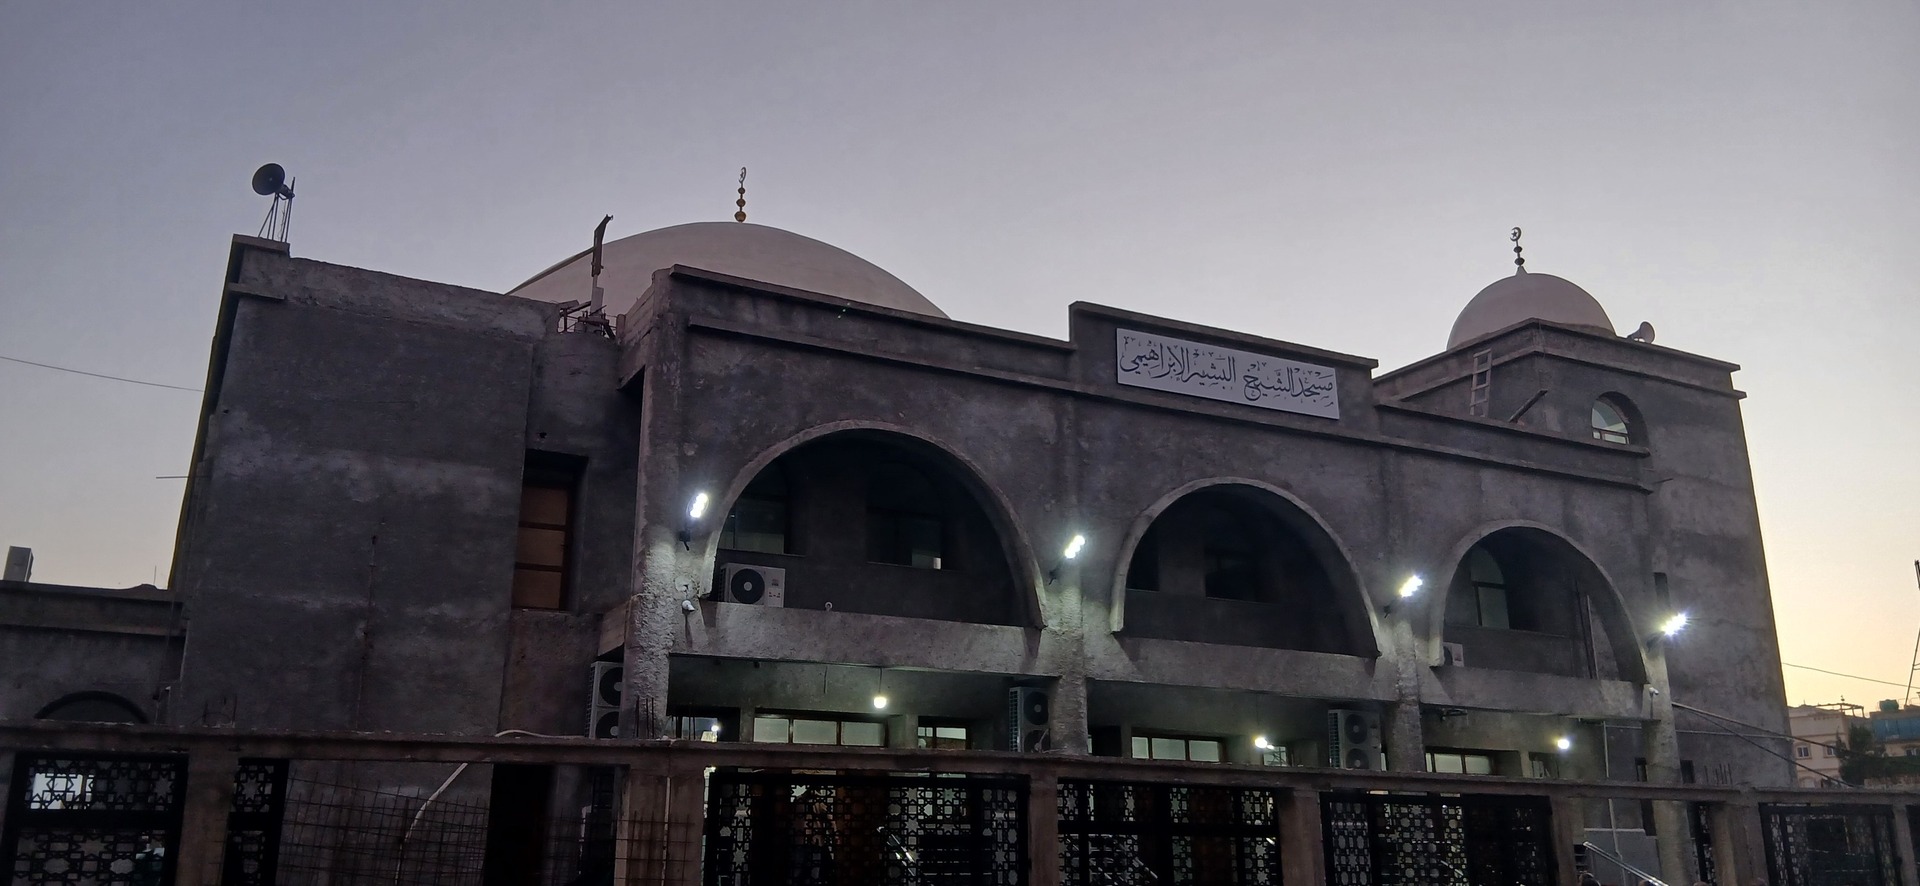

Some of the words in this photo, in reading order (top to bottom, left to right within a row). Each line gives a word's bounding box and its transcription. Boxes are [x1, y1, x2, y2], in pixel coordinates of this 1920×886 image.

[1181, 350, 1236, 389] البشير
[1243, 362, 1295, 401] الشيخ
[1291, 368, 1334, 406] مسجد
